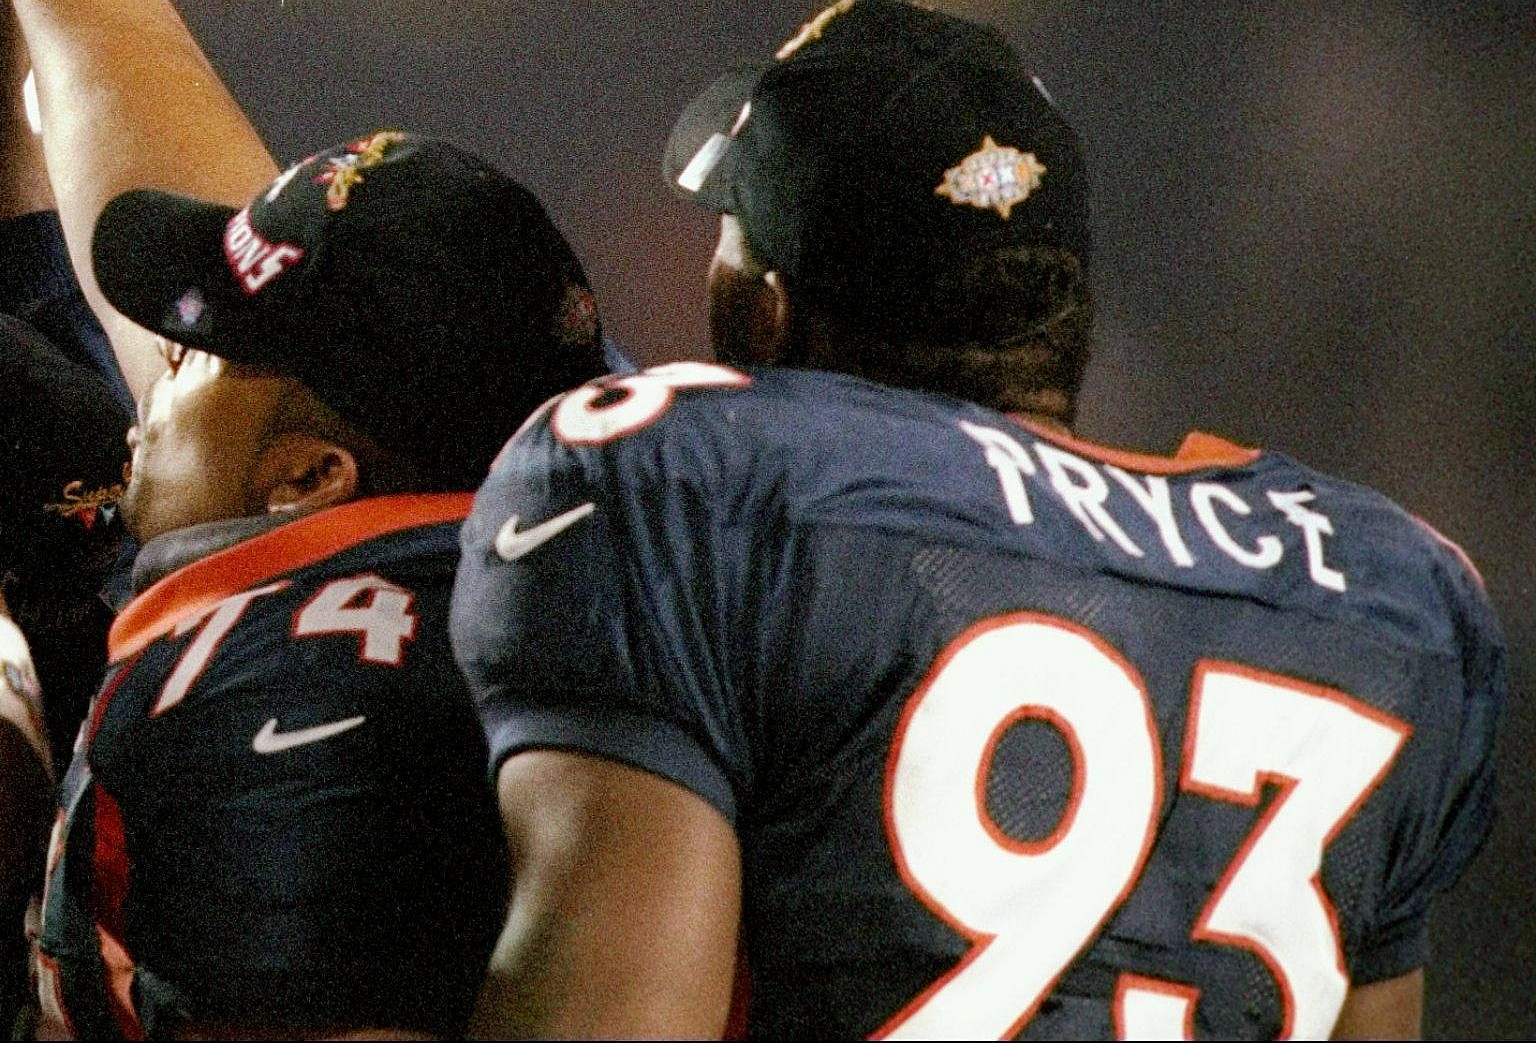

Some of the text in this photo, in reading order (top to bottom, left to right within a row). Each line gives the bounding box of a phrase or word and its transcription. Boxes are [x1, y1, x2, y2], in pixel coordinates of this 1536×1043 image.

[959, 419, 1348, 593] PRYCE
[150, 571, 420, 718] 74
[884, 611, 1412, 1041] 93
